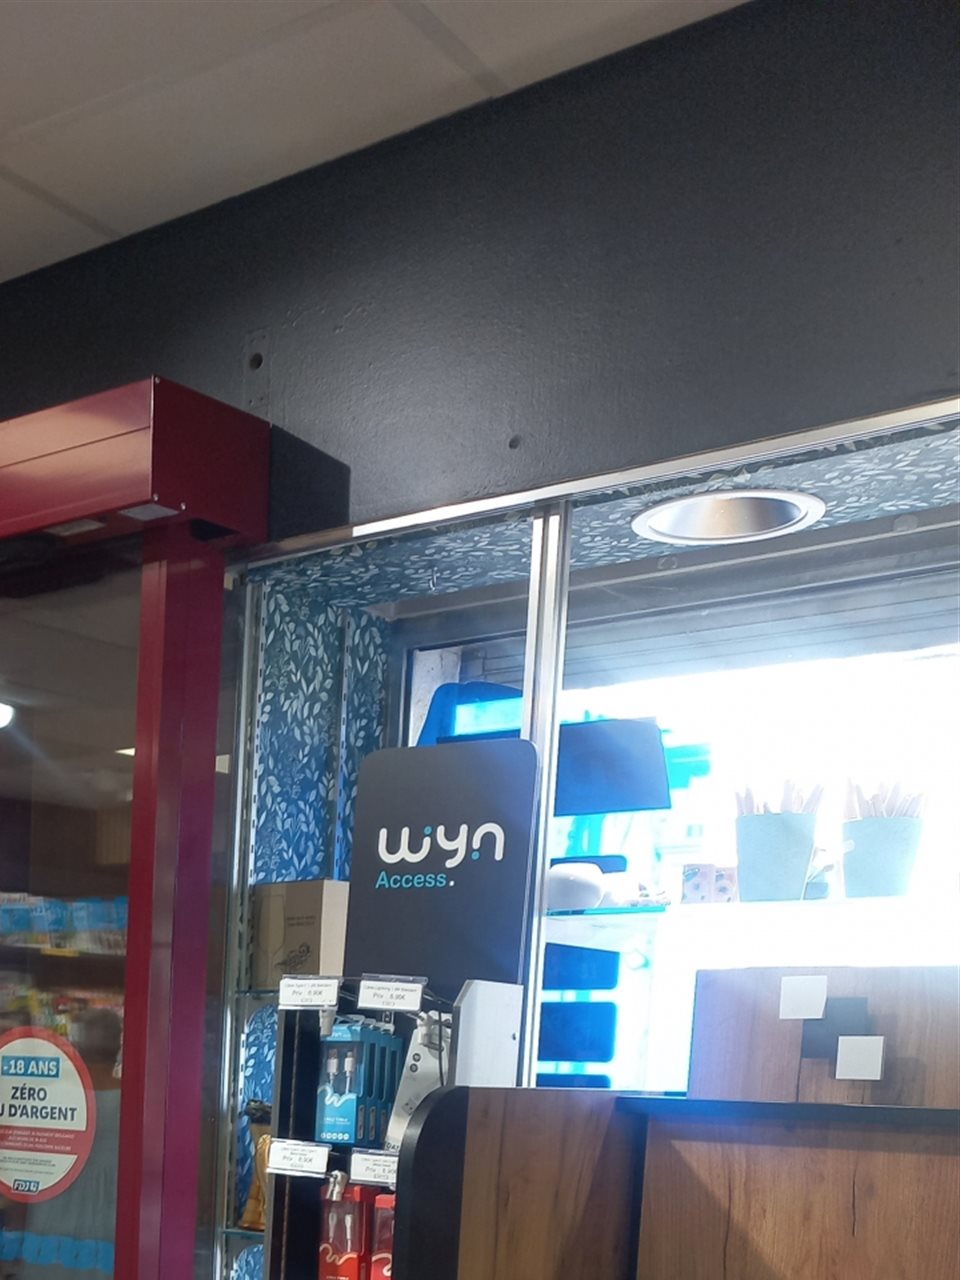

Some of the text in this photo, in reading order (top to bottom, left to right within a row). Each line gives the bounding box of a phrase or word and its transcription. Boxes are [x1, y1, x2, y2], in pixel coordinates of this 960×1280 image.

[3, 1059, 57, 1075] -18 ANS
[11, 1083, 47, 1102] ZÉRO
[8, 1105, 78, 1122] D'ARGENT
